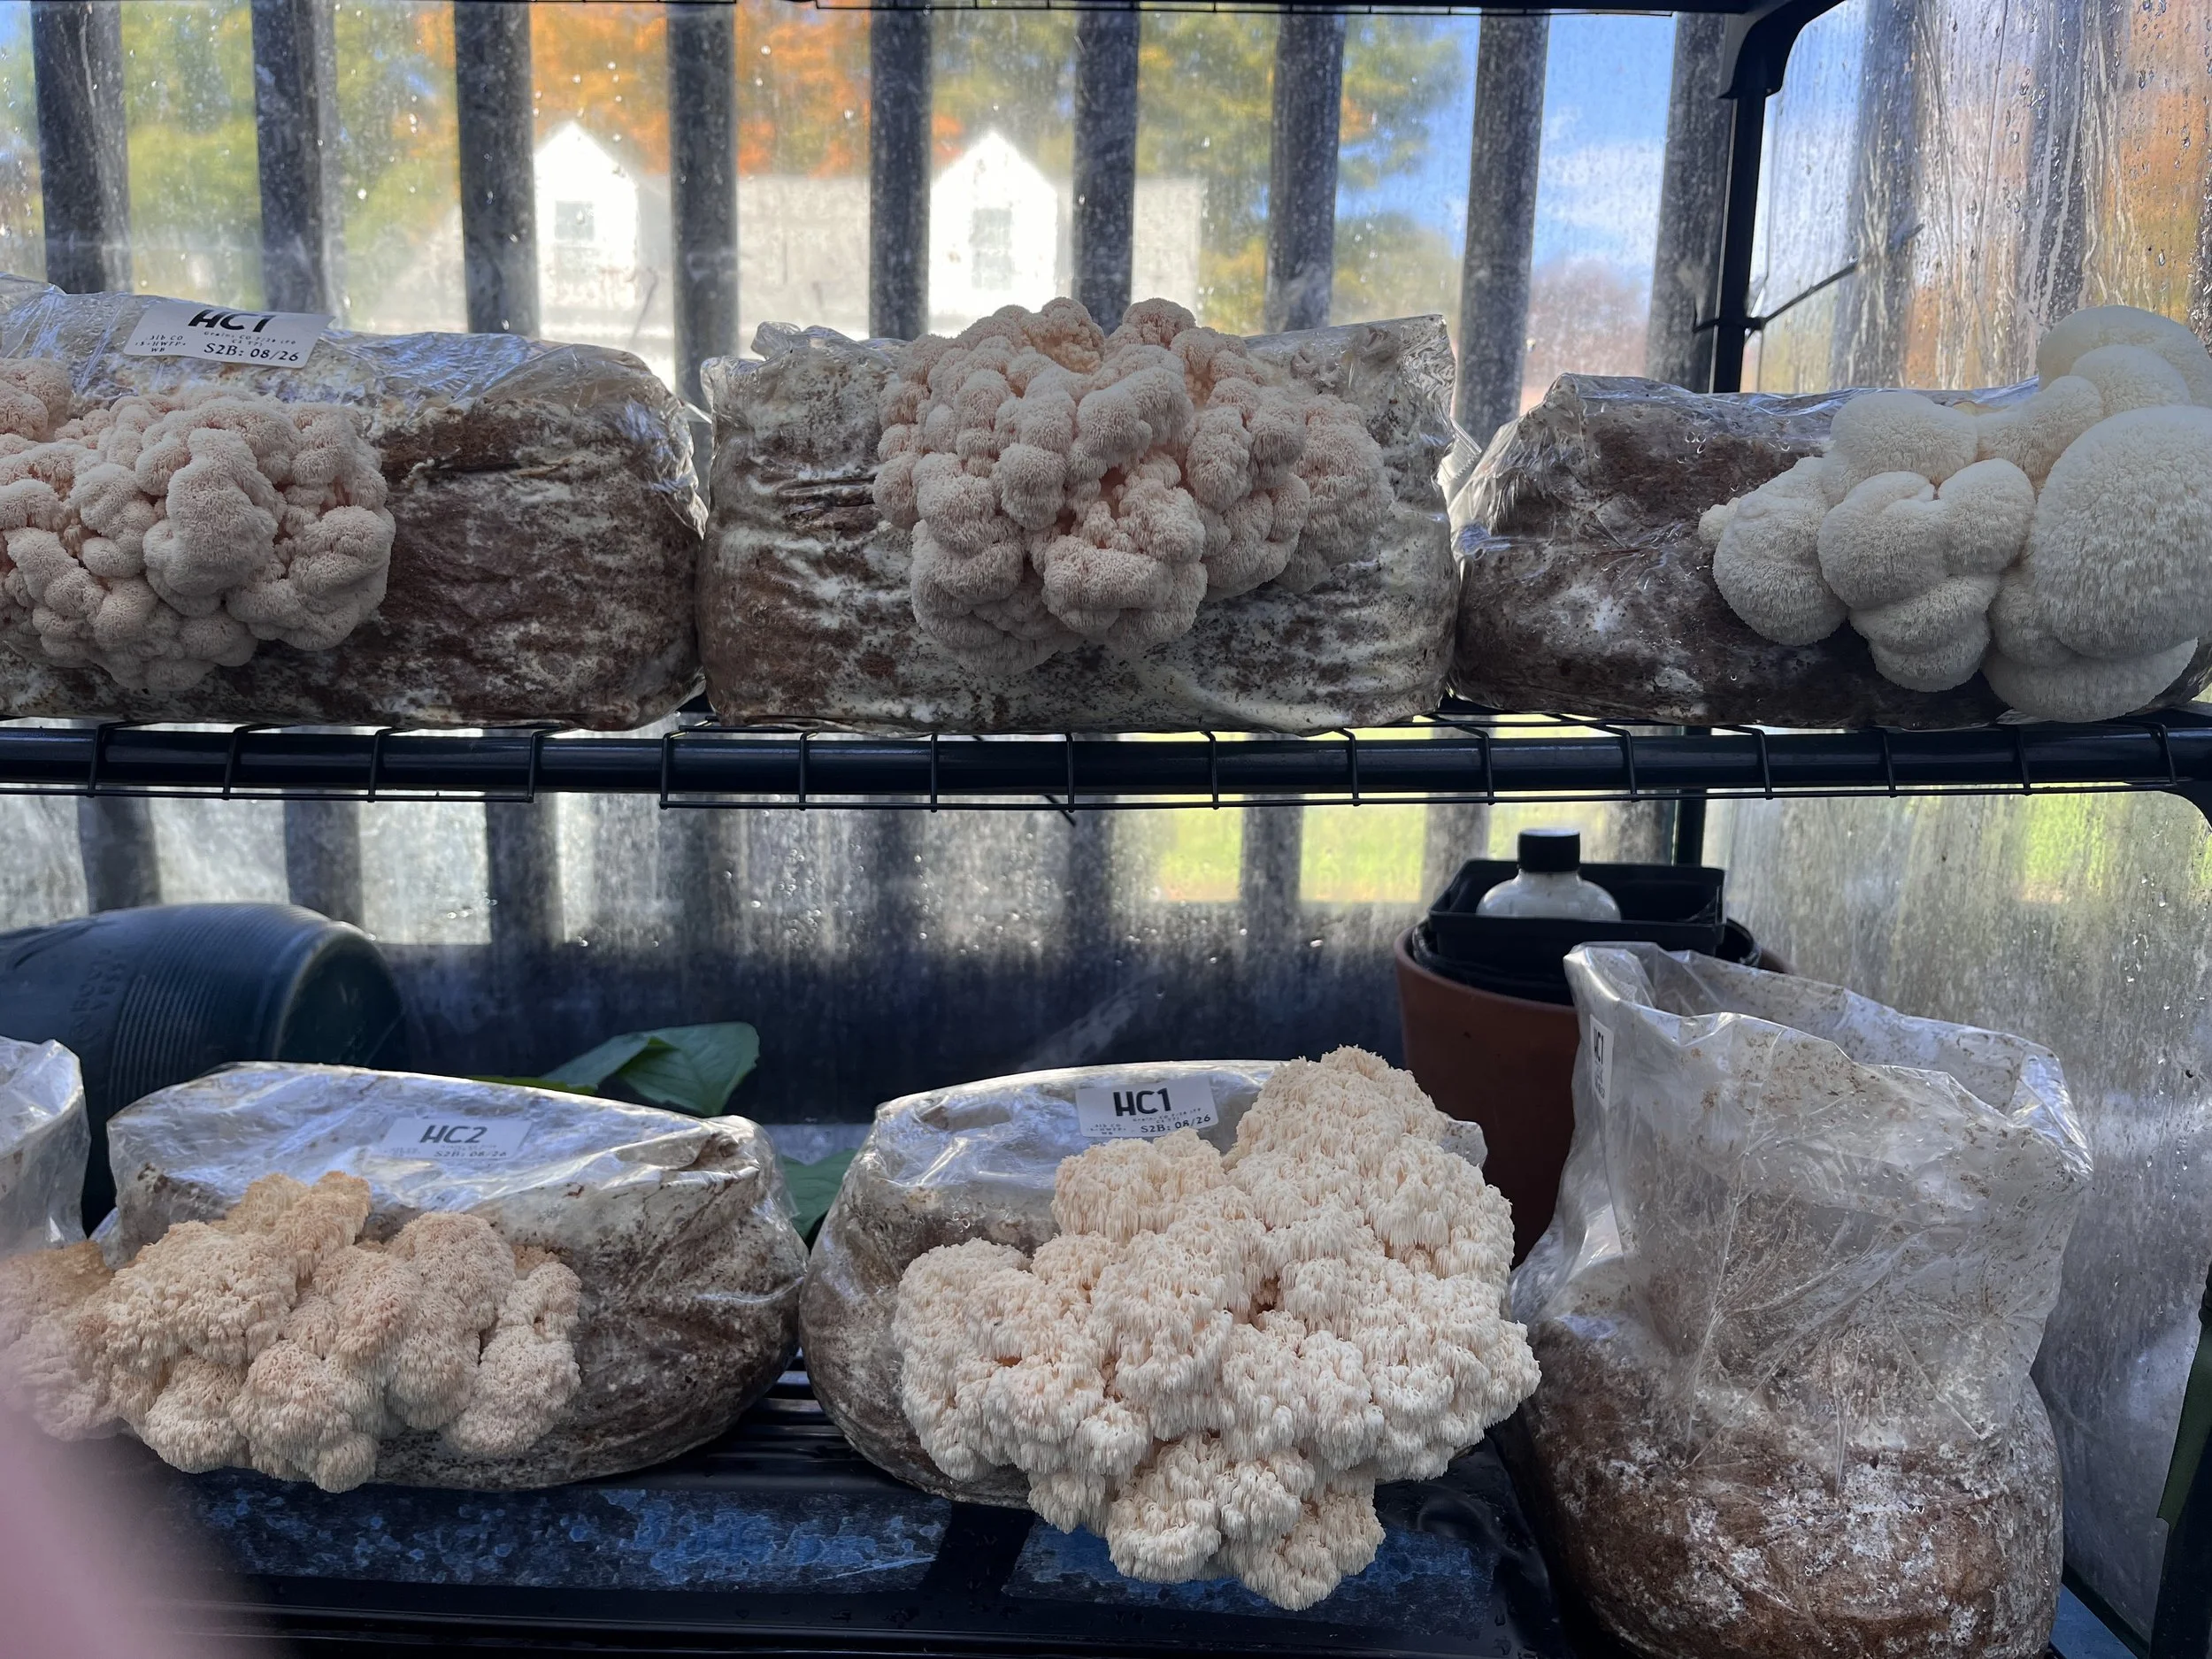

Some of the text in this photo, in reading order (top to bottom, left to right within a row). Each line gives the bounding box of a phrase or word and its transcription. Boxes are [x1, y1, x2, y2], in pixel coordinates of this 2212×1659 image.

[188, 309, 277, 333] HC1
[204, 342, 300, 362] S2B: 08/26
[1112, 1087, 1171, 1117] HC1
[1141, 1124, 1171, 1133] S2B:
[1174, 1114, 1211, 1129] 08/26
[419, 1125, 488, 1143] HC2
